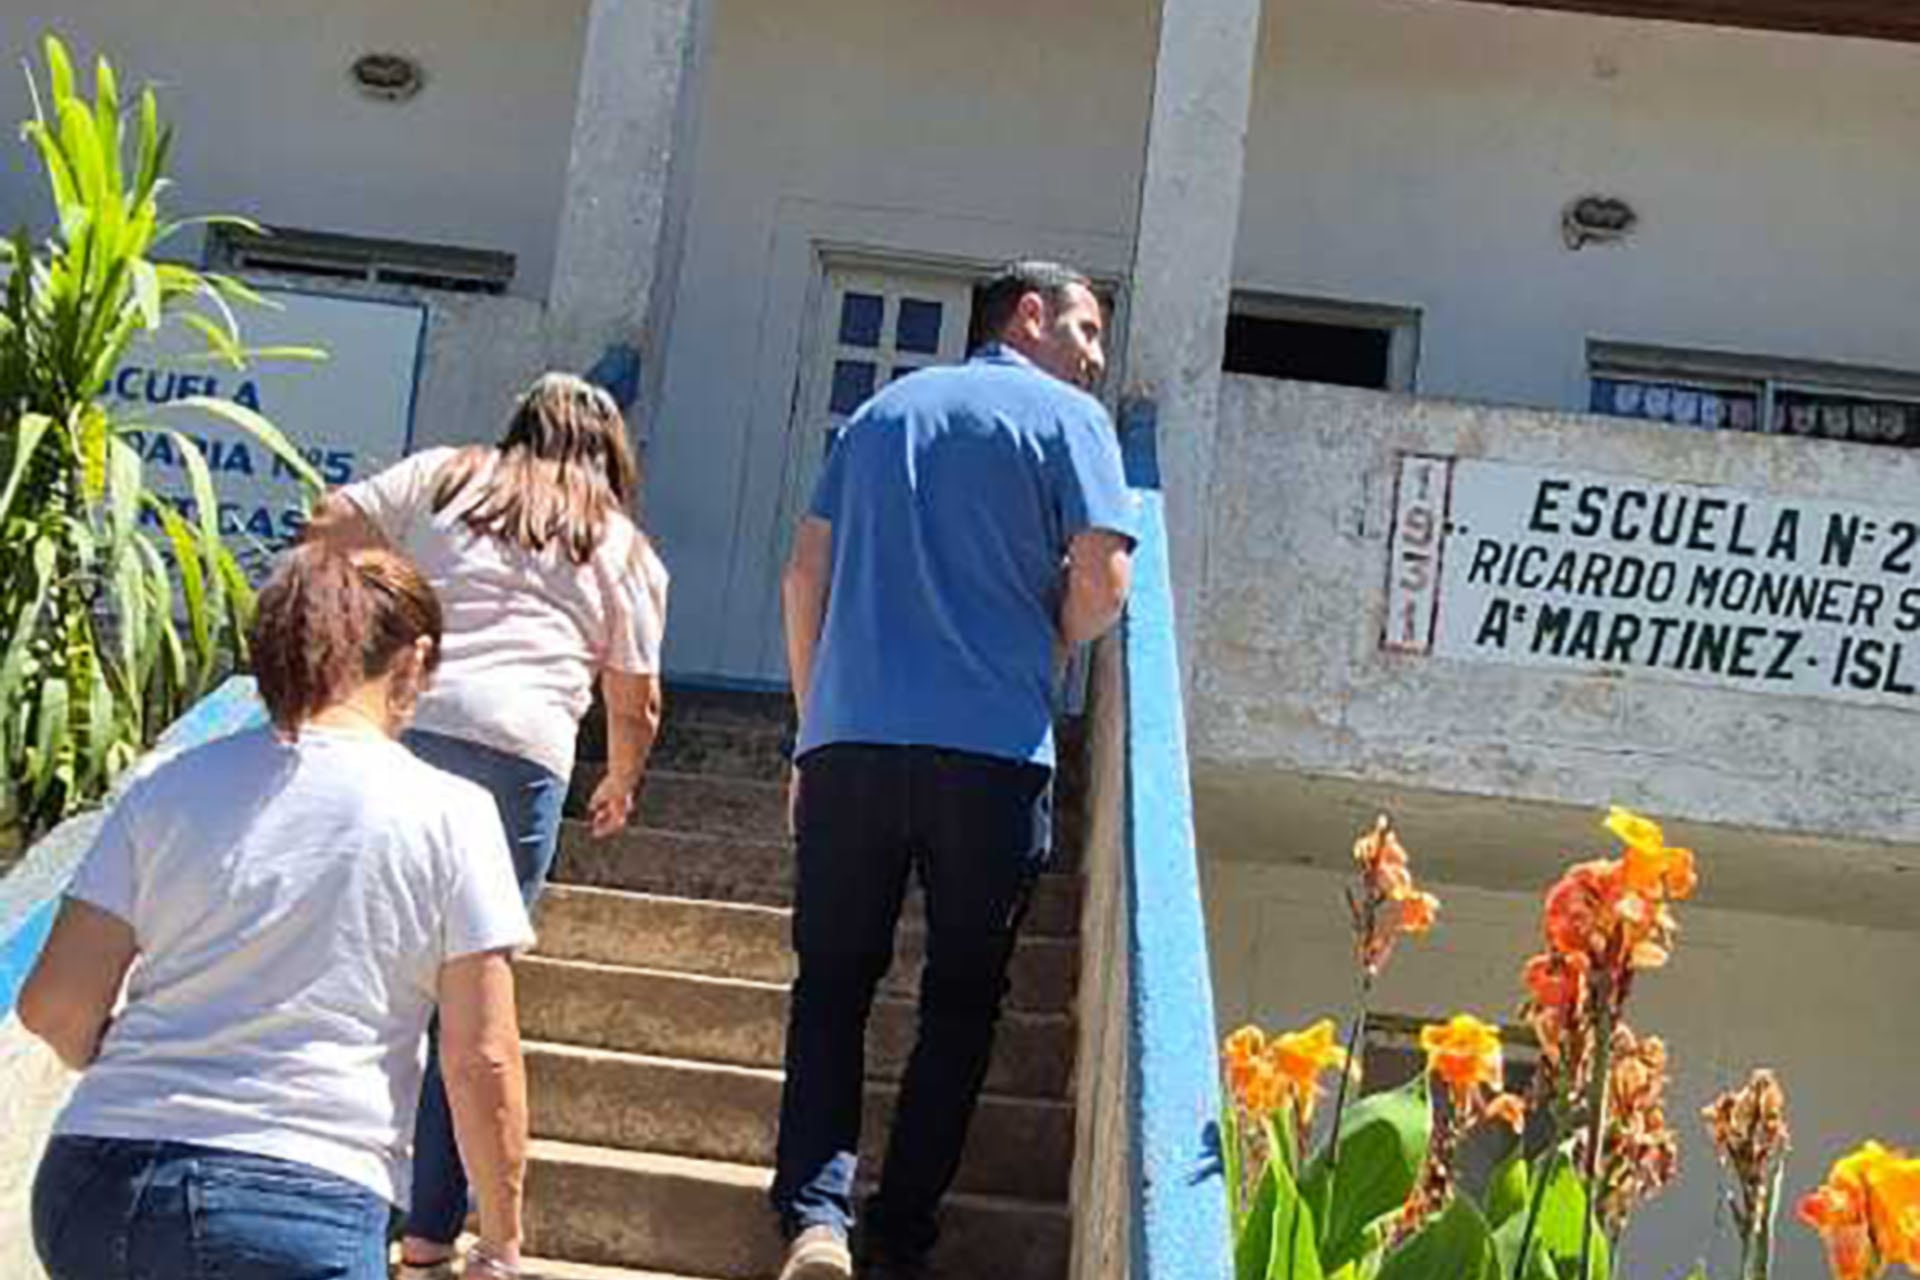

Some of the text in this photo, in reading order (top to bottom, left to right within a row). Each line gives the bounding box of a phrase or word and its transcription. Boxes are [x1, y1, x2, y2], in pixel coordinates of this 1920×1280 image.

[1528, 479, 1800, 562] ESCUELA
[1467, 538, 1677, 603] RICARDO
[1685, 564, 1884, 627] MONNER
[1530, 602, 1803, 680] MARTINEZ
[1831, 636, 1915, 694] ISL
